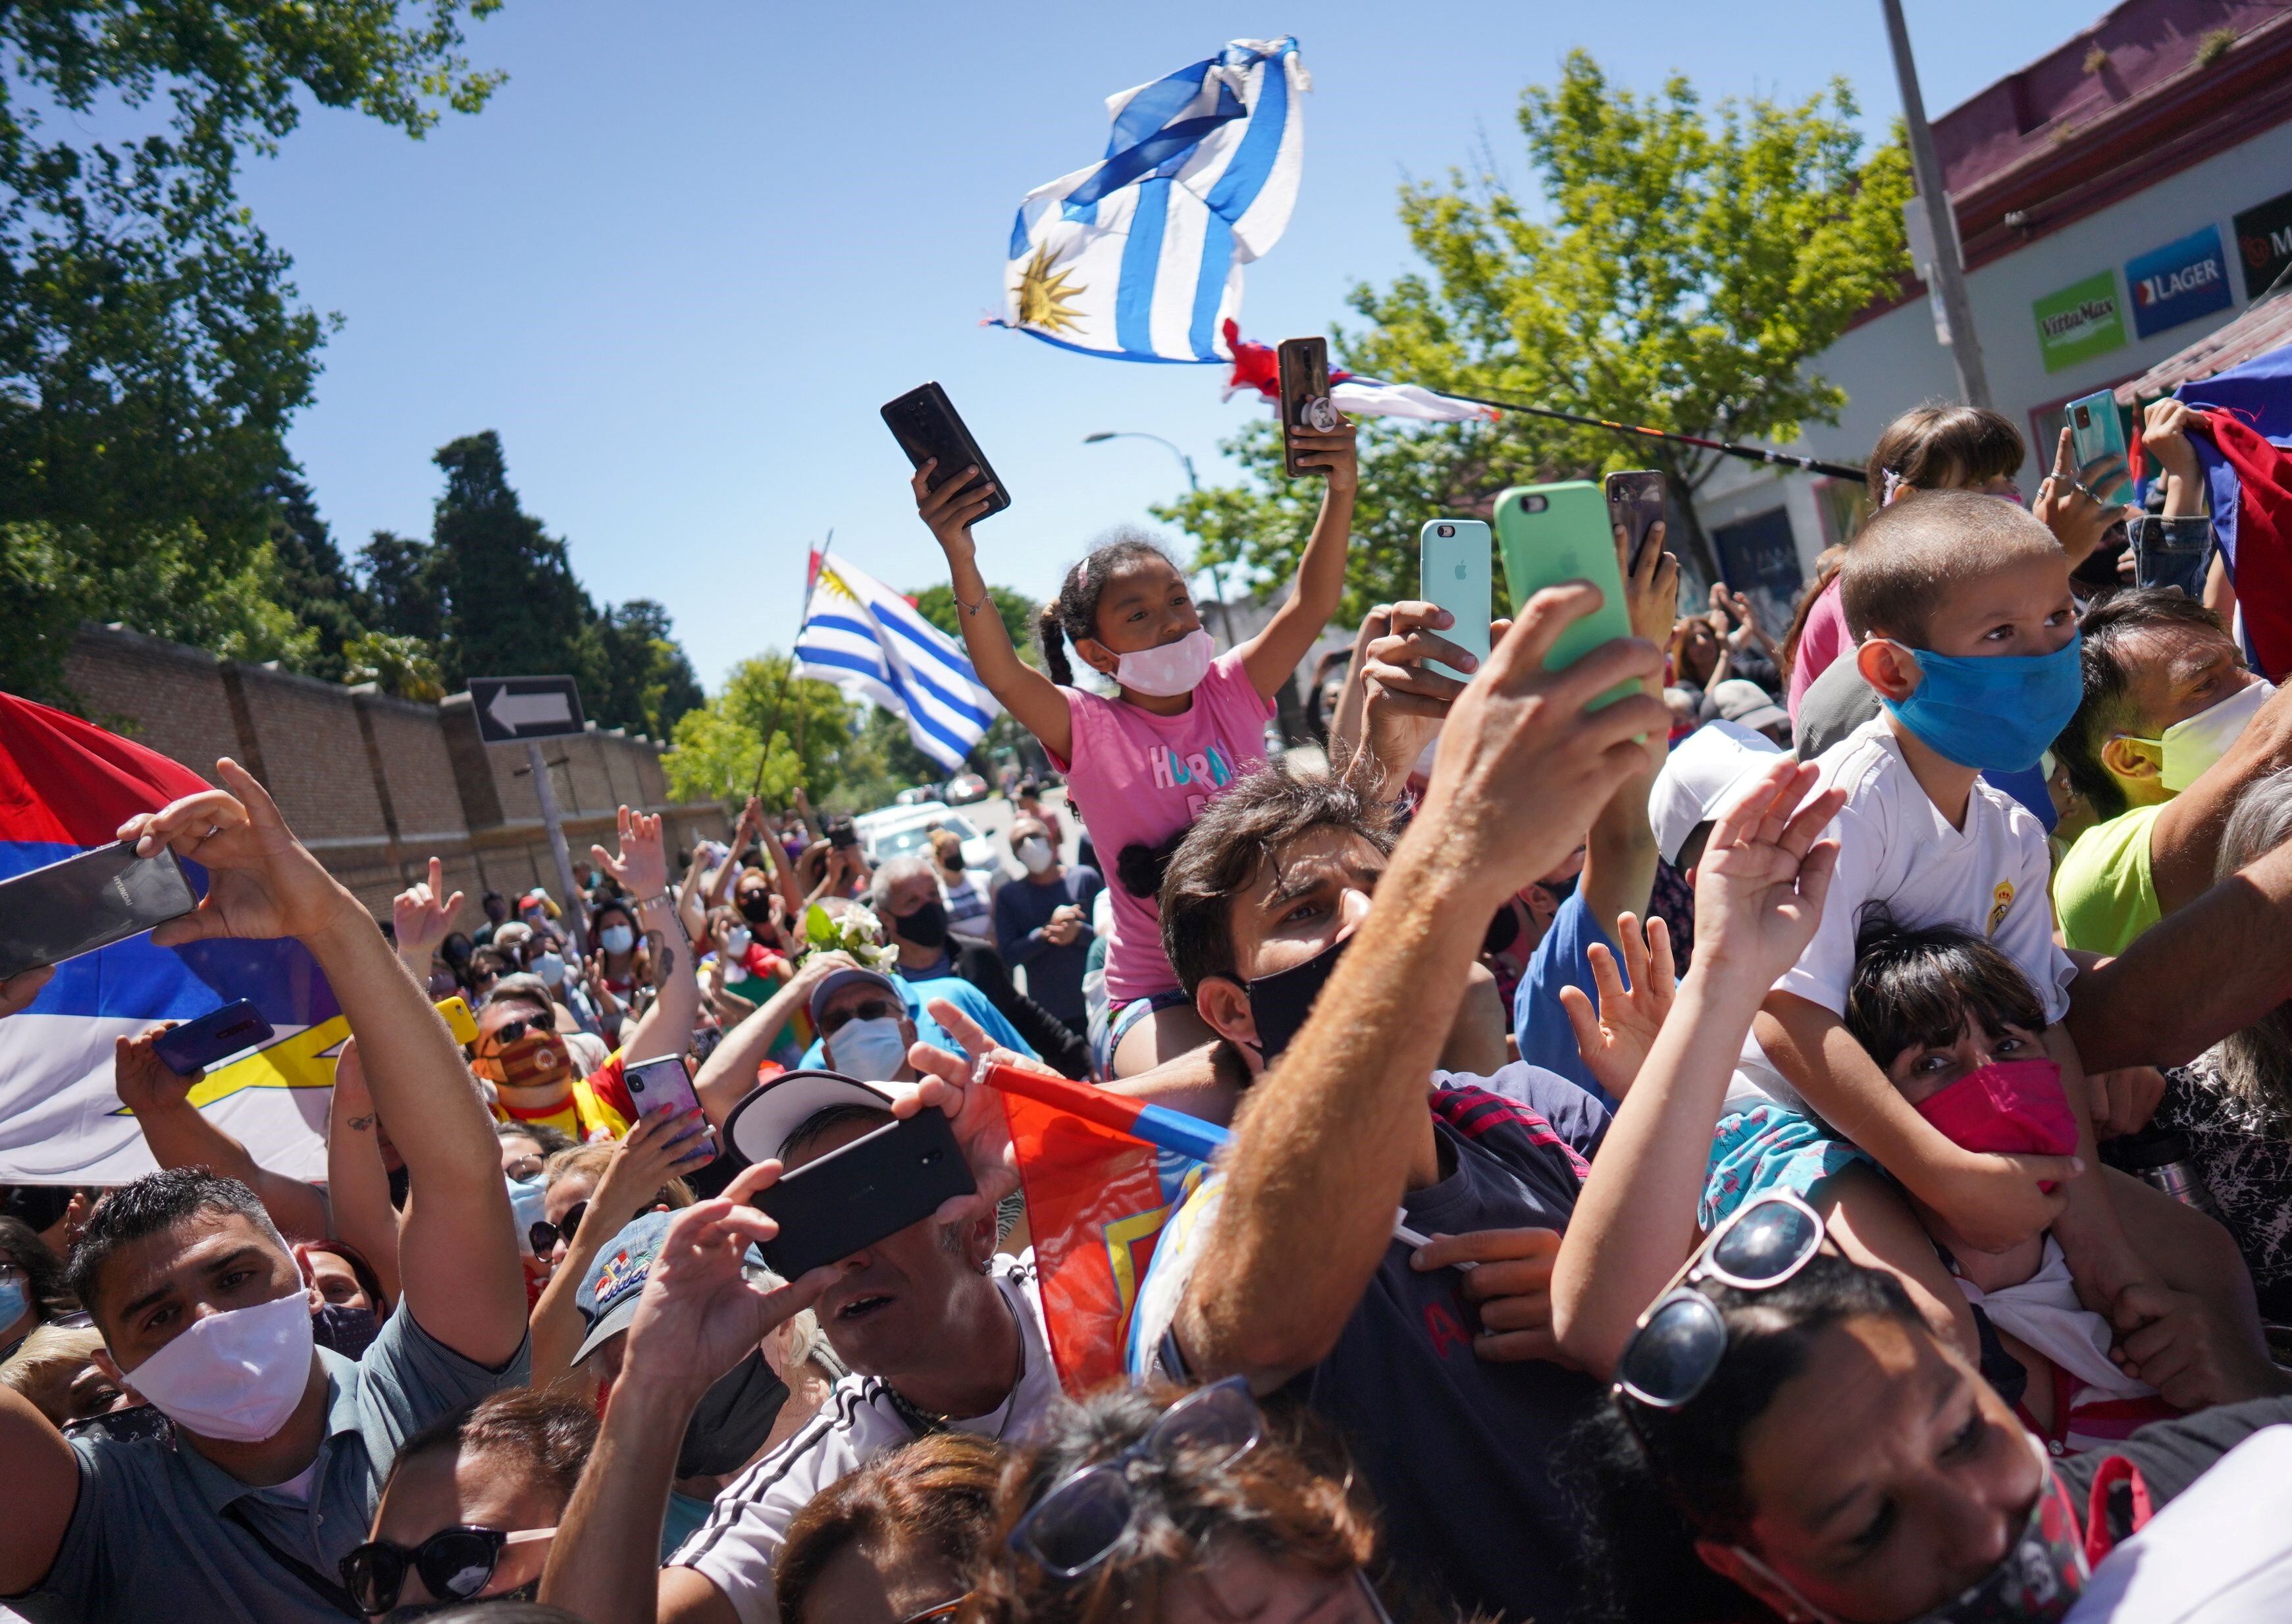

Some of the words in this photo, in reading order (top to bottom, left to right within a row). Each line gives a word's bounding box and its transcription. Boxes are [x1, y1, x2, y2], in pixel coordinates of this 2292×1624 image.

[2154, 259, 2218, 300] LAGER
[2041, 299, 2114, 338] VittaMax
[113, 875, 133, 906] HYUNDAI
